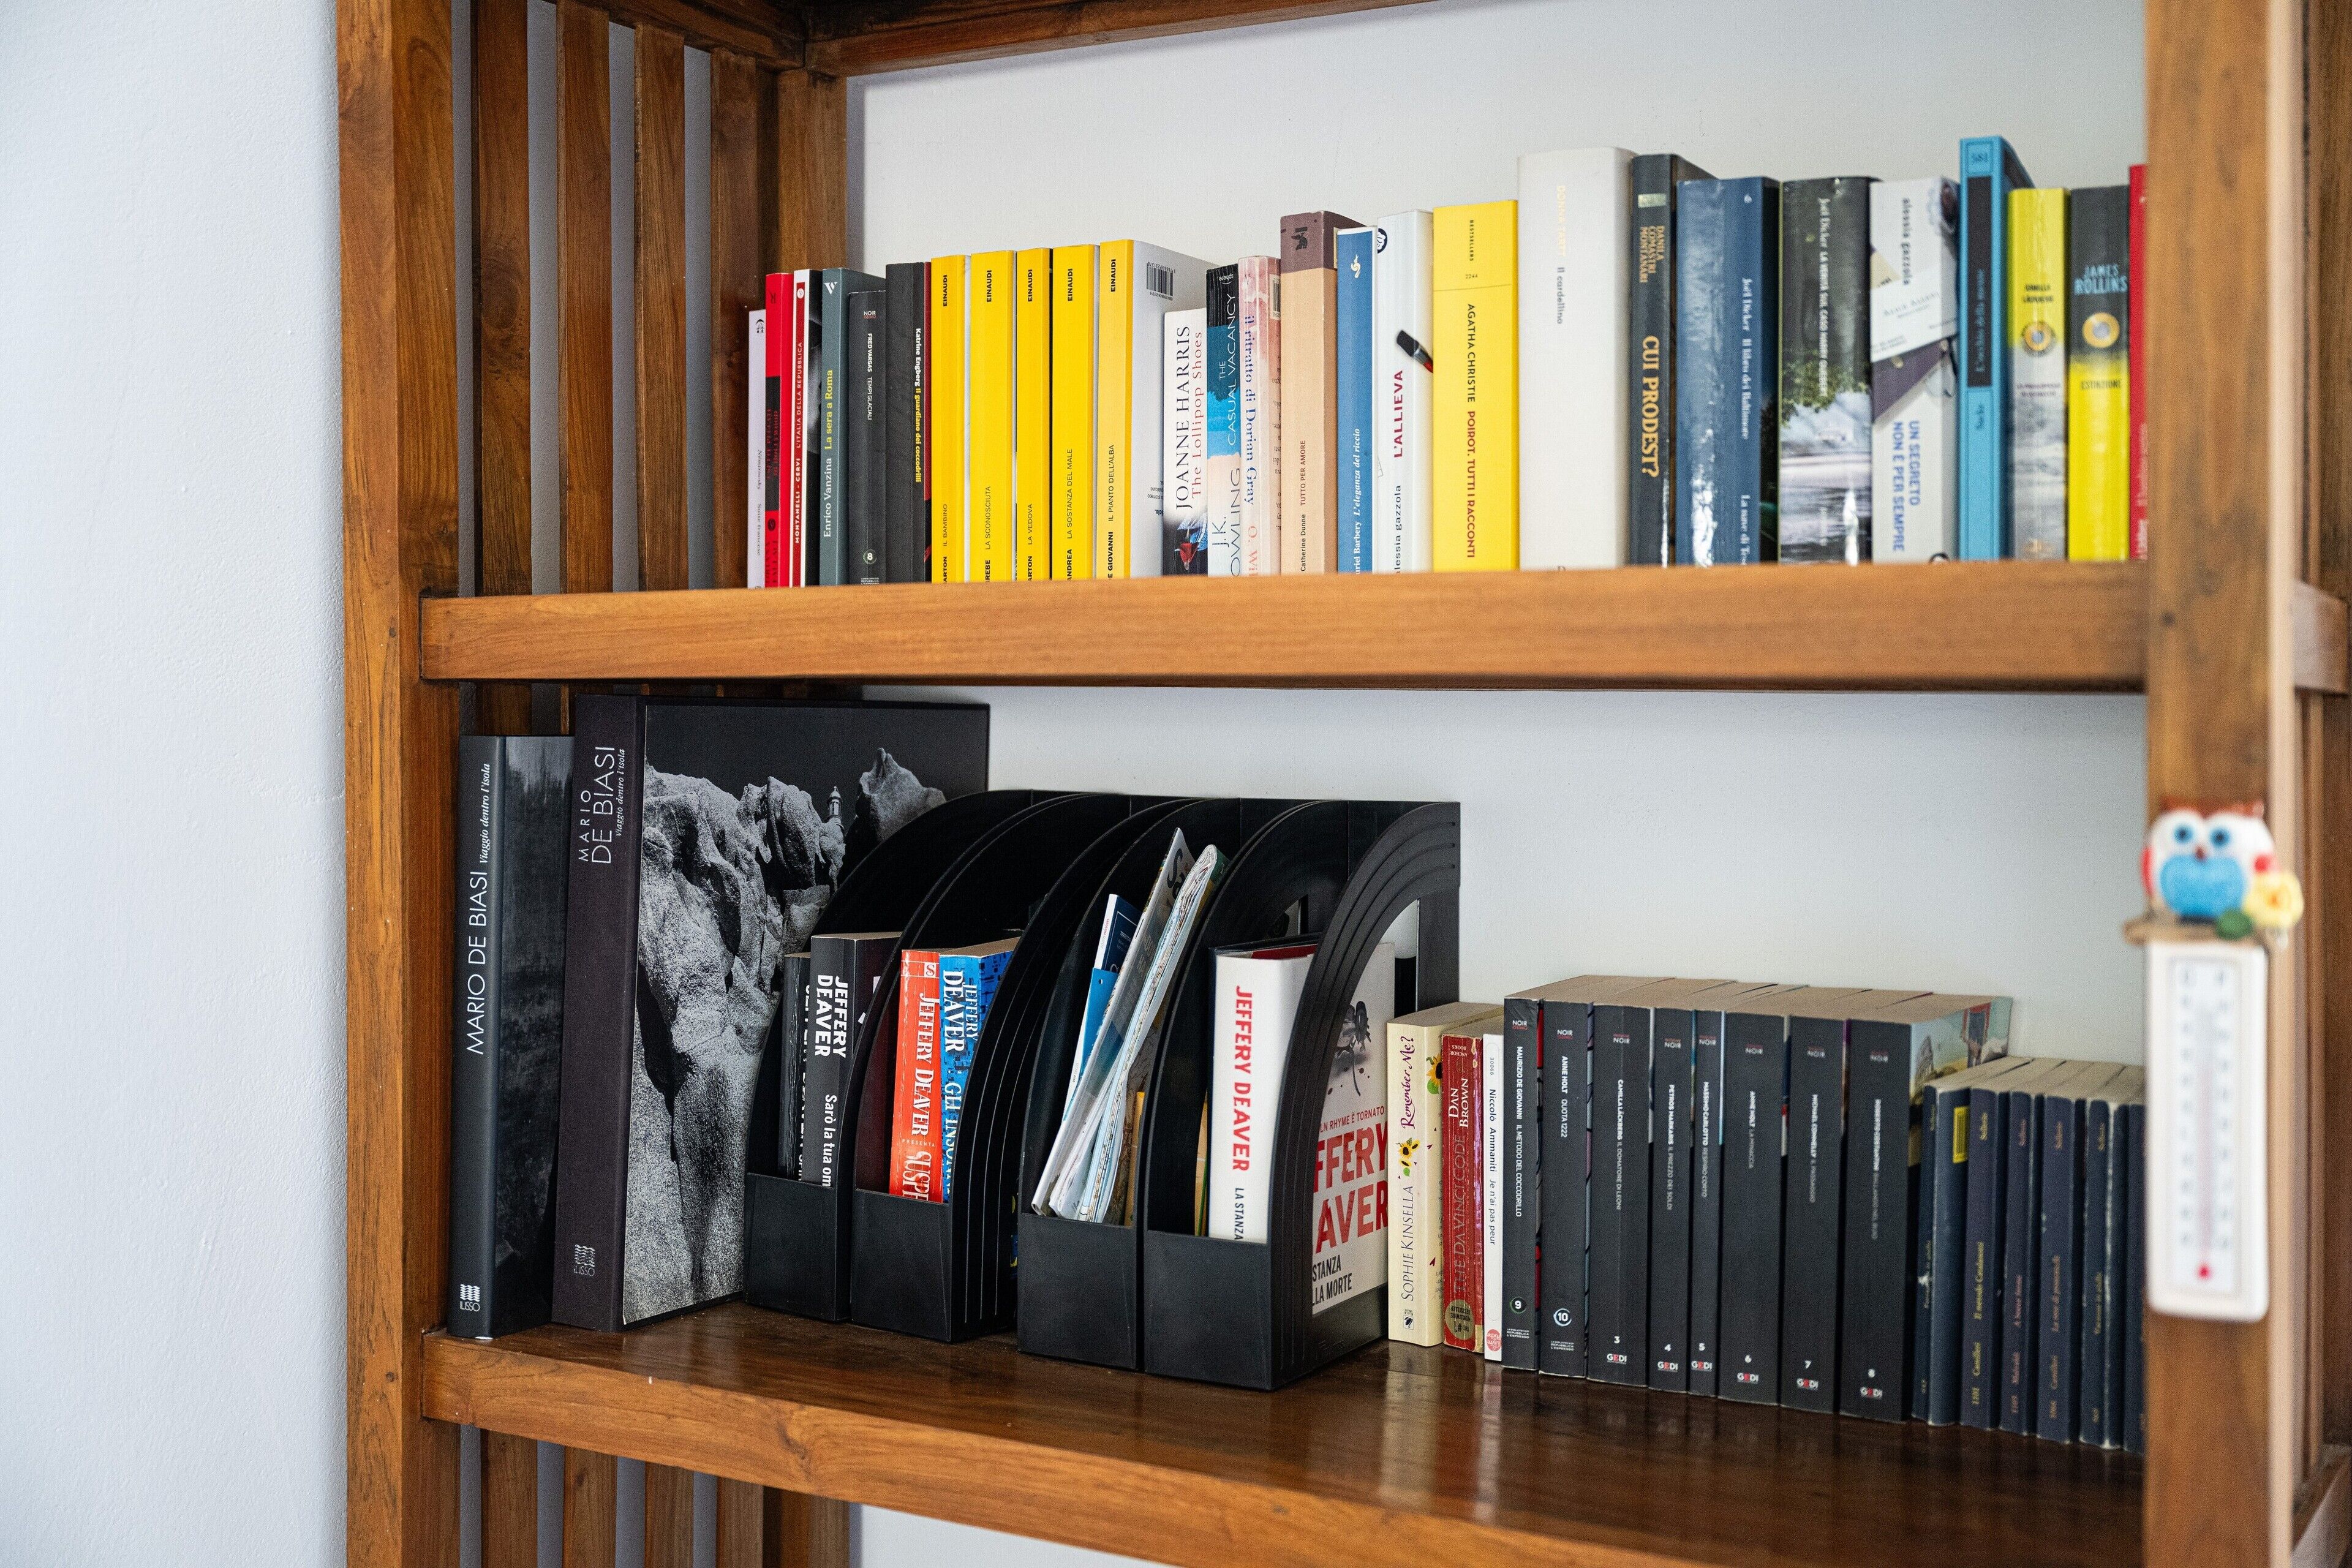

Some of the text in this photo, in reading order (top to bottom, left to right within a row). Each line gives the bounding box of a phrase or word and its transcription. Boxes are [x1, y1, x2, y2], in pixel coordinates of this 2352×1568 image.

[1639, 226, 1649, 283] MONTANARI
[1648, 225, 1657, 274] COMASTRI
[1656, 225, 1665, 261] DANILA
[1557, 275, 1566, 325] cardellino
[1741, 277, 1752, 297] Joël
[2074, 275, 2128, 295] ROLLINS
[1467, 303, 1476, 350] AGATHA
[1741, 299, 1752, 331] Dicker
[1226, 293, 1237, 445] CASUAL VACANCY
[1467, 352, 1476, 403] CHRISTIE
[1741, 348, 1752, 372] libro
[1741, 374, 1752, 390] dei
[824, 370, 834, 399] Roma
[1641, 336, 1660, 477] CUI PRODEST?
[824, 411, 833, 434] sera
[1175, 326, 1193, 509] JOANNE HARRIS
[1191, 331, 1204, 499] The Lollipop Shoes
[1244, 315, 1257, 506] il ritratto di Dorian Gray
[1393, 369, 1403, 458] L'ALLIEVA
[1466, 410, 1476, 457] POIROT.
[1741, 391, 1752, 440] Baltimore
[824, 436, 833, 450] La
[1909, 420, 1921, 507] UN SEGRETO
[823, 458, 832, 500] Vanzina
[1466, 459, 1476, 492] TUTTI
[1893, 421, 1907, 552] NON È PER SEMPRE
[823, 503, 832, 538] Enrico
[1393, 484, 1404, 530] gazzola
[1466, 500, 1476, 558] RACCONTI
[1066, 529, 1072, 539] LA
[1211, 517, 1228, 548] J.K.
[591, 746, 616, 864] DE BIASI
[616, 778, 625, 805] dentro
[578, 790, 591, 861] MARIO
[615, 807, 625, 837] Viaggio
[466, 763, 491, 1055] MARIO DE BIASI Viaggio dentro l'isola
[815, 974, 831, 1057] DEAVER
[831, 975, 848, 1058] JEFFERY
[943, 970, 965, 1052] DEAVER
[961, 984, 978, 1042] JEFFERY
[911, 992, 940, 1136] JEFFERY DEAVER
[1400, 1036, 1416, 1130] Remember Me?
[1516, 1079, 1523, 1087] DE
[824, 1094, 837, 1125] Sarò
[1232, 986, 1253, 1240] JEFFERY DEAVER LA STANZA
[1447, 1087, 1459, 1118] DAN
[1458, 1077, 1470, 1128] BROWN
[1490, 1088, 1498, 1121] Niccolò
[823, 1127, 836, 1141] la
[823, 1142, 835, 1164] tua
[1313, 1121, 1388, 1194] FFERY
[1315, 1180, 1388, 1254] AVER
[1401, 1186, 1414, 1251] KINSELLA
[1453, 1134, 1466, 1293] THE DA VINCI CODE
[1313, 1254, 1342, 1283] STANZA
[1401, 1254, 1414, 1302] SOPHIE
[1450, 1306, 1471, 1315] BESTSELLER
[1557, 1312, 1569, 1322] 10
